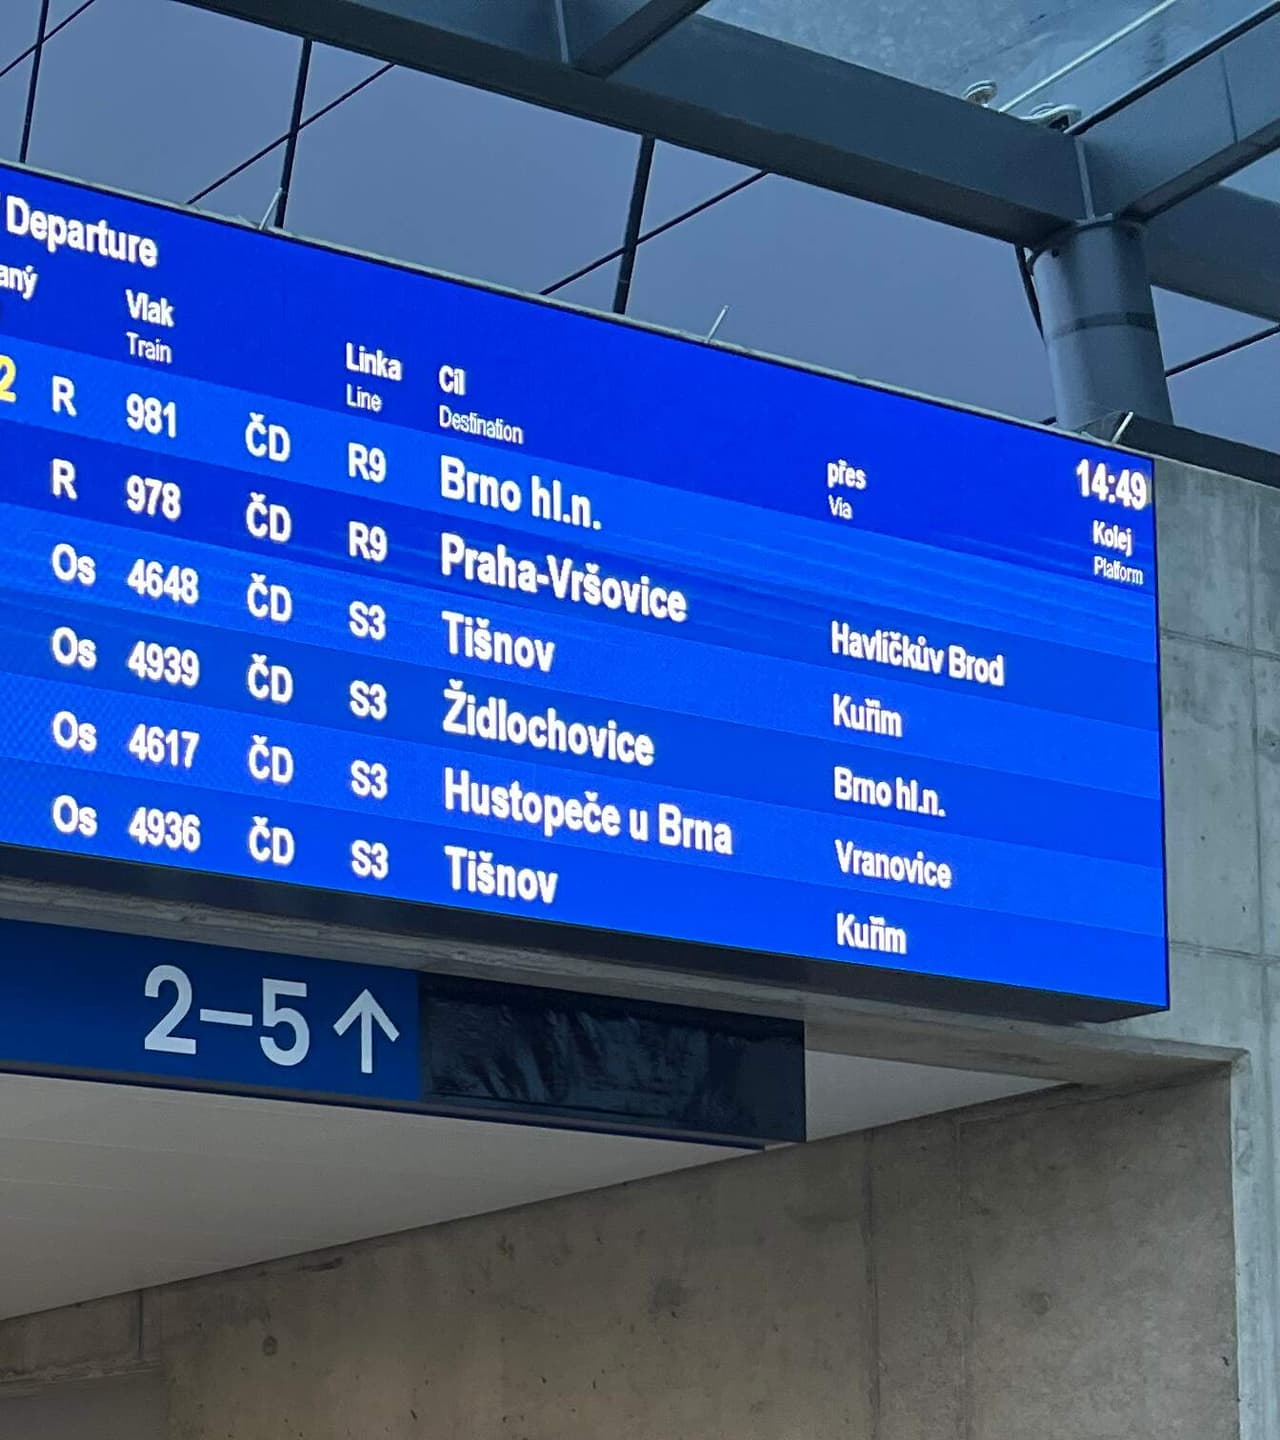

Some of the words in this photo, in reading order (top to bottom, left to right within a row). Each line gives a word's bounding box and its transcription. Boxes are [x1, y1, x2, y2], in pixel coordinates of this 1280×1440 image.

[5, 194, 159, 268] Departure
[125, 289, 174, 327] Vlak
[126, 331, 172, 364] Train
[346, 342, 402, 381] Linka
[52, 375, 77, 416] R
[126, 393, 176, 438] 981
[346, 383, 382, 412] Line
[245, 412, 291, 462] ČD
[439, 404, 523, 444] Destination
[52, 458, 77, 500] R
[348, 442, 386, 483] R9
[827, 459, 866, 490] přes
[1076, 458, 1147, 511] 14:49
[126, 474, 181, 520] 978
[440, 454, 522, 512] Brno
[531, 475, 601, 530] hl.n.
[246, 492, 292, 542] ČD
[1092, 519, 1133, 557] Kolej
[349, 520, 388, 562] R9
[51, 543, 96, 586] Os
[127, 558, 199, 605] 4648
[441, 532, 687, 624] Praha-Vršovice
[1094, 555, 1144, 585] Platform
[247, 572, 292, 622] ČD
[349, 600, 386, 641] S3
[441, 610, 555, 672] Tišnov
[51, 626, 97, 669] Os
[127, 640, 200, 687] 4939
[831, 620, 945, 674] Havlíčkův
[948, 645, 1005, 687] Brod
[247, 653, 293, 703] ČD
[349, 680, 387, 720] S3
[52, 710, 97, 753] Os
[442, 678, 654, 769] Židlochovice
[833, 693, 902, 737] Kuřim
[128, 723, 200, 769] 4617
[248, 734, 294, 784] ČD
[350, 759, 388, 799] S3
[834, 766, 893, 807] Brno
[895, 777, 946, 817] hl.n.
[52, 794, 98, 837] Os
[128, 806, 201, 852] 4936
[444, 767, 621, 837] Hustopeče
[629, 808, 649, 842] u
[658, 803, 733, 855] Brna
[248, 815, 295, 865] ČD
[351, 839, 389, 879] S3
[444, 845, 558, 904] Tišnov
[834, 839, 952, 889] Vranovice
[836, 912, 907, 954] Kuřim
